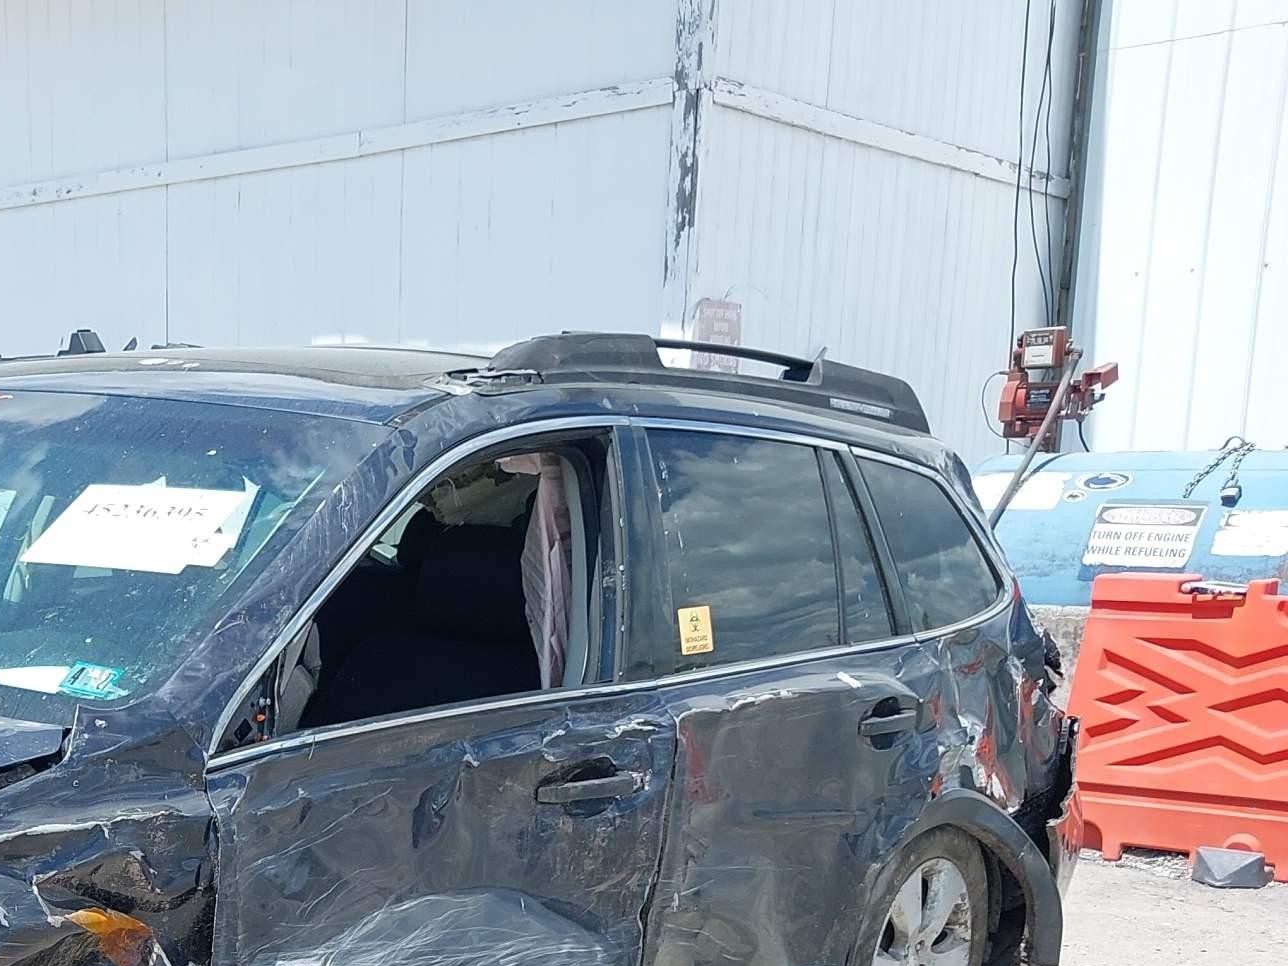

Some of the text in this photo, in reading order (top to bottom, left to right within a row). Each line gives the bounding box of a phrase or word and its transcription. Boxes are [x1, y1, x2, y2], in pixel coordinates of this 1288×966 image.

[1092, 529, 1192, 543] TURN OFF ENGINE
[1087, 545, 1187, 558] WHILE REFUELING
